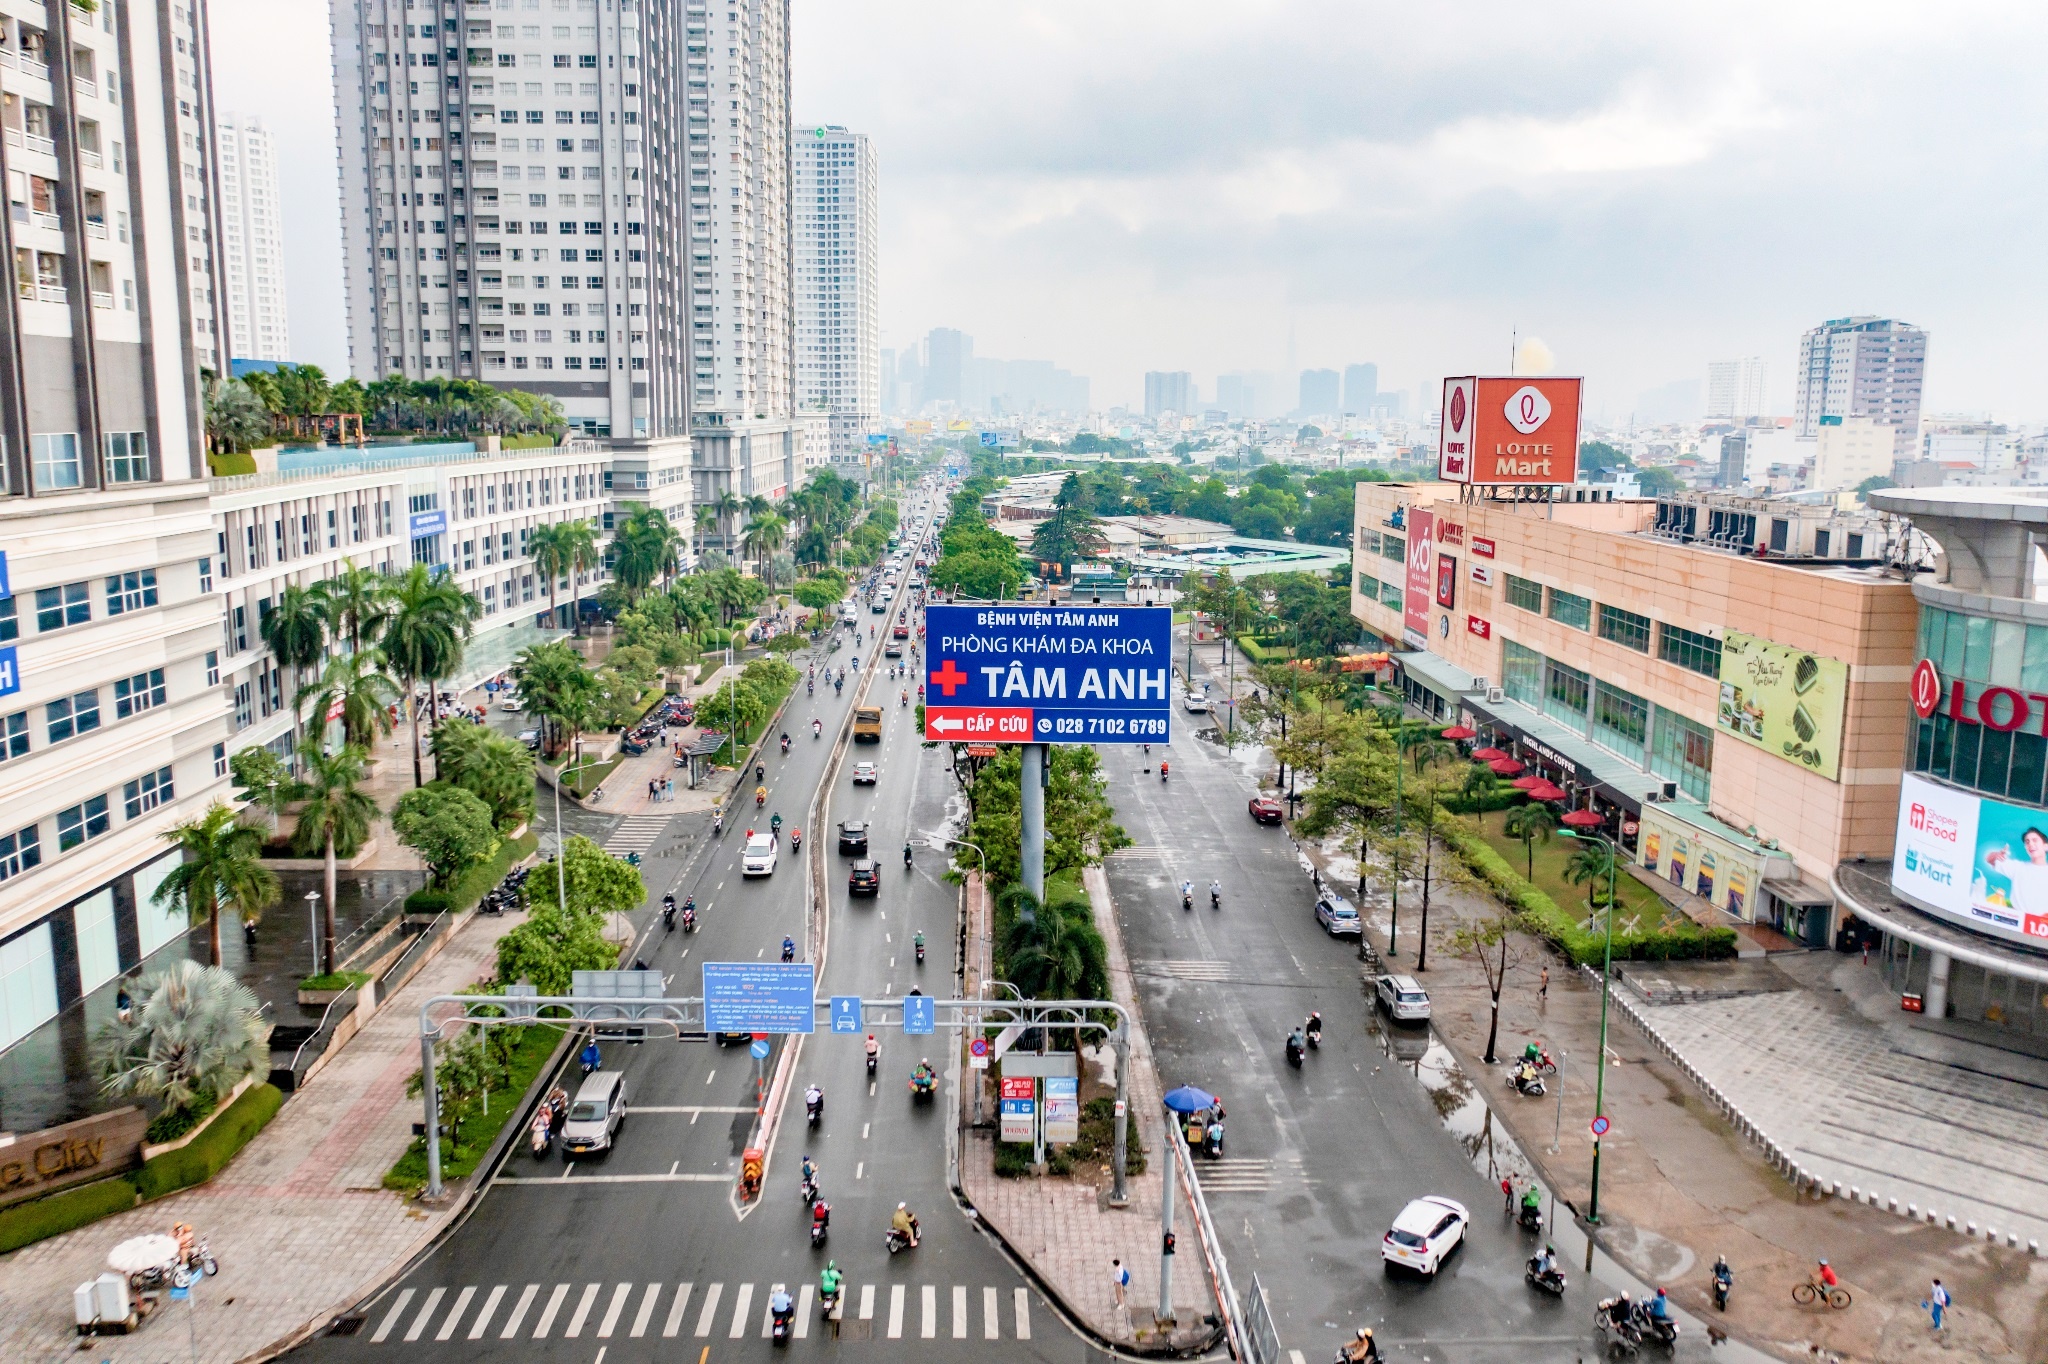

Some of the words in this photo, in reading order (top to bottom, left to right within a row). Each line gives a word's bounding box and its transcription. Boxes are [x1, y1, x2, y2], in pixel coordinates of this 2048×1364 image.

[1448, 442, 1464, 454] LOTTE
[1496, 443, 1553, 456] LOTTE
[1446, 456, 1464, 475] Mart
[1495, 458, 1552, 476] Mart
[1445, 522, 1463, 538] LOTTE
[978, 610, 1016, 628] BỆNH
[1019, 611, 1051, 629] VIỆN
[1055, 613, 1084, 627] TÂM
[1088, 614, 1118, 627] ANH
[942, 634, 1007, 653] PHÒNG
[1013, 635, 1066, 654] KHÁM
[1070, 639, 1097, 654] ĐA
[1102, 639, 1153, 654] KHOA
[980, 660, 1067, 699] TÂM
[1078, 668, 1166, 700] ANH
[966, 713, 994, 732] CẤP
[1000, 715, 1028, 732] CỨU
[1056, 718, 1084, 734] 028
[1089, 718, 1125, 734] 7102
[1130, 719, 1166, 734] 6789
[1523, 734, 1554, 760] HIGHLANDS
[1554, 754, 1576, 774] COFFEE
[1928, 808, 1958, 827] Shopee
[1926, 820, 1956, 842] Food
[1920, 861, 1952, 886] Mart
[1005, 1101, 1016, 1111] ila
[34, 1136, 105, 1175] City
